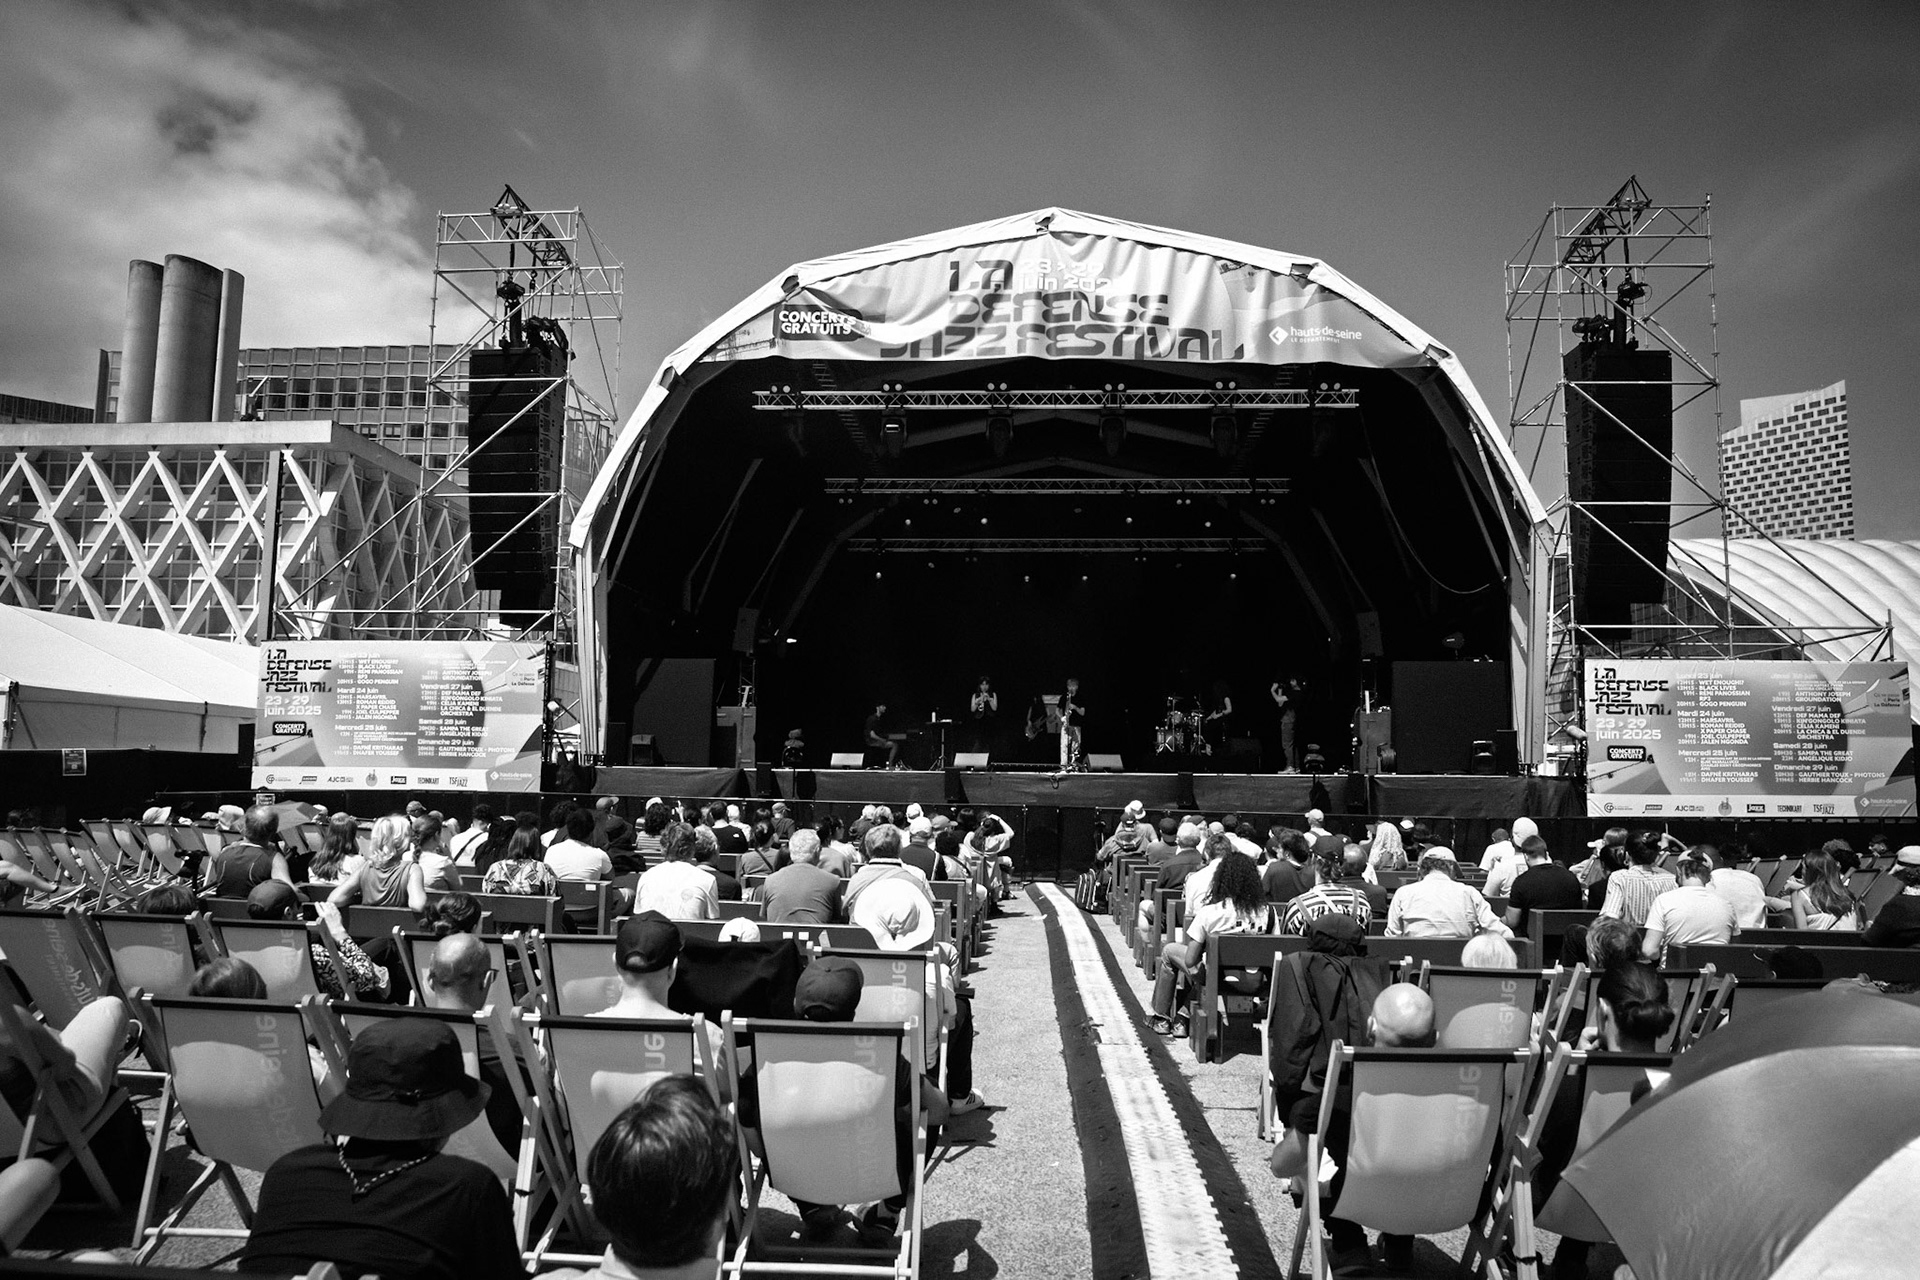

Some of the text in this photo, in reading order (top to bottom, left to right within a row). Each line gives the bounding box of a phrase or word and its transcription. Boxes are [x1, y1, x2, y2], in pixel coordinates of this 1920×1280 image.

[950, 261, 1014, 292] LA
[779, 310, 856, 325] CONCERTS
[781, 322, 851, 335] GRATUITS
[268, 649, 286, 659] LA
[268, 660, 332, 670] DEFENSE
[261, 672, 298, 681] JAZZ
[1594, 668, 1616, 679] LA
[266, 682, 332, 693] FESTIVAL
[1595, 680, 1669, 691] DEFENSE
[265, 696, 310, 705] 23 29
[1589, 692, 1631, 702] JAZZ
[264, 706, 322, 718] juin 2025
[1596, 704, 1671, 716] FESTIVAL
[1596, 718, 1646, 729] 23 29
[1596, 729, 1662, 742] juin 2025
[1814, 742, 1828, 750] juin
[1814, 804, 1834, 814] TSF JAZZ
